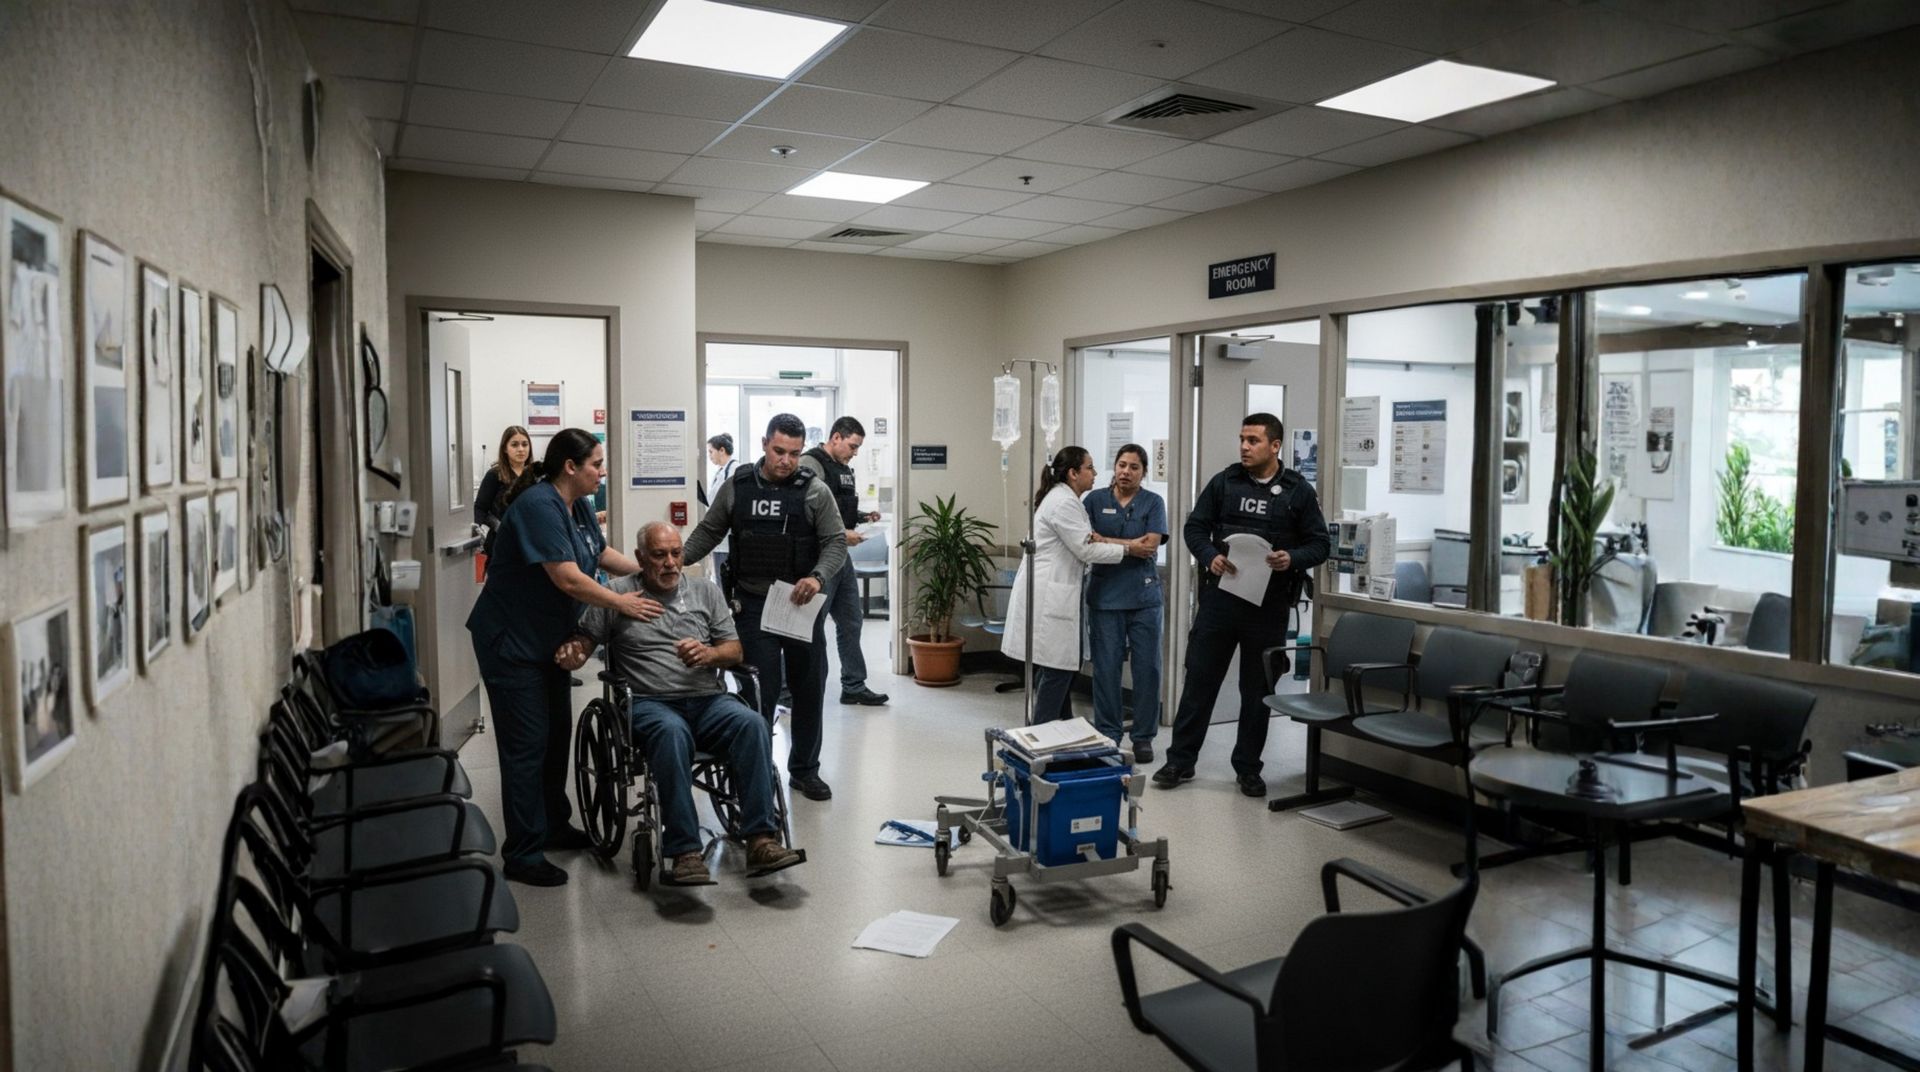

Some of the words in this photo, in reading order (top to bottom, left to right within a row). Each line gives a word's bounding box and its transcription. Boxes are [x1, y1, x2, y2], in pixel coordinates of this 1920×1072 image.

[1212, 257, 1271, 279] EMERGENCY
[1226, 276, 1256, 292] ROOM
[751, 499, 782, 516] ICE
[1239, 496, 1268, 515] ICE
